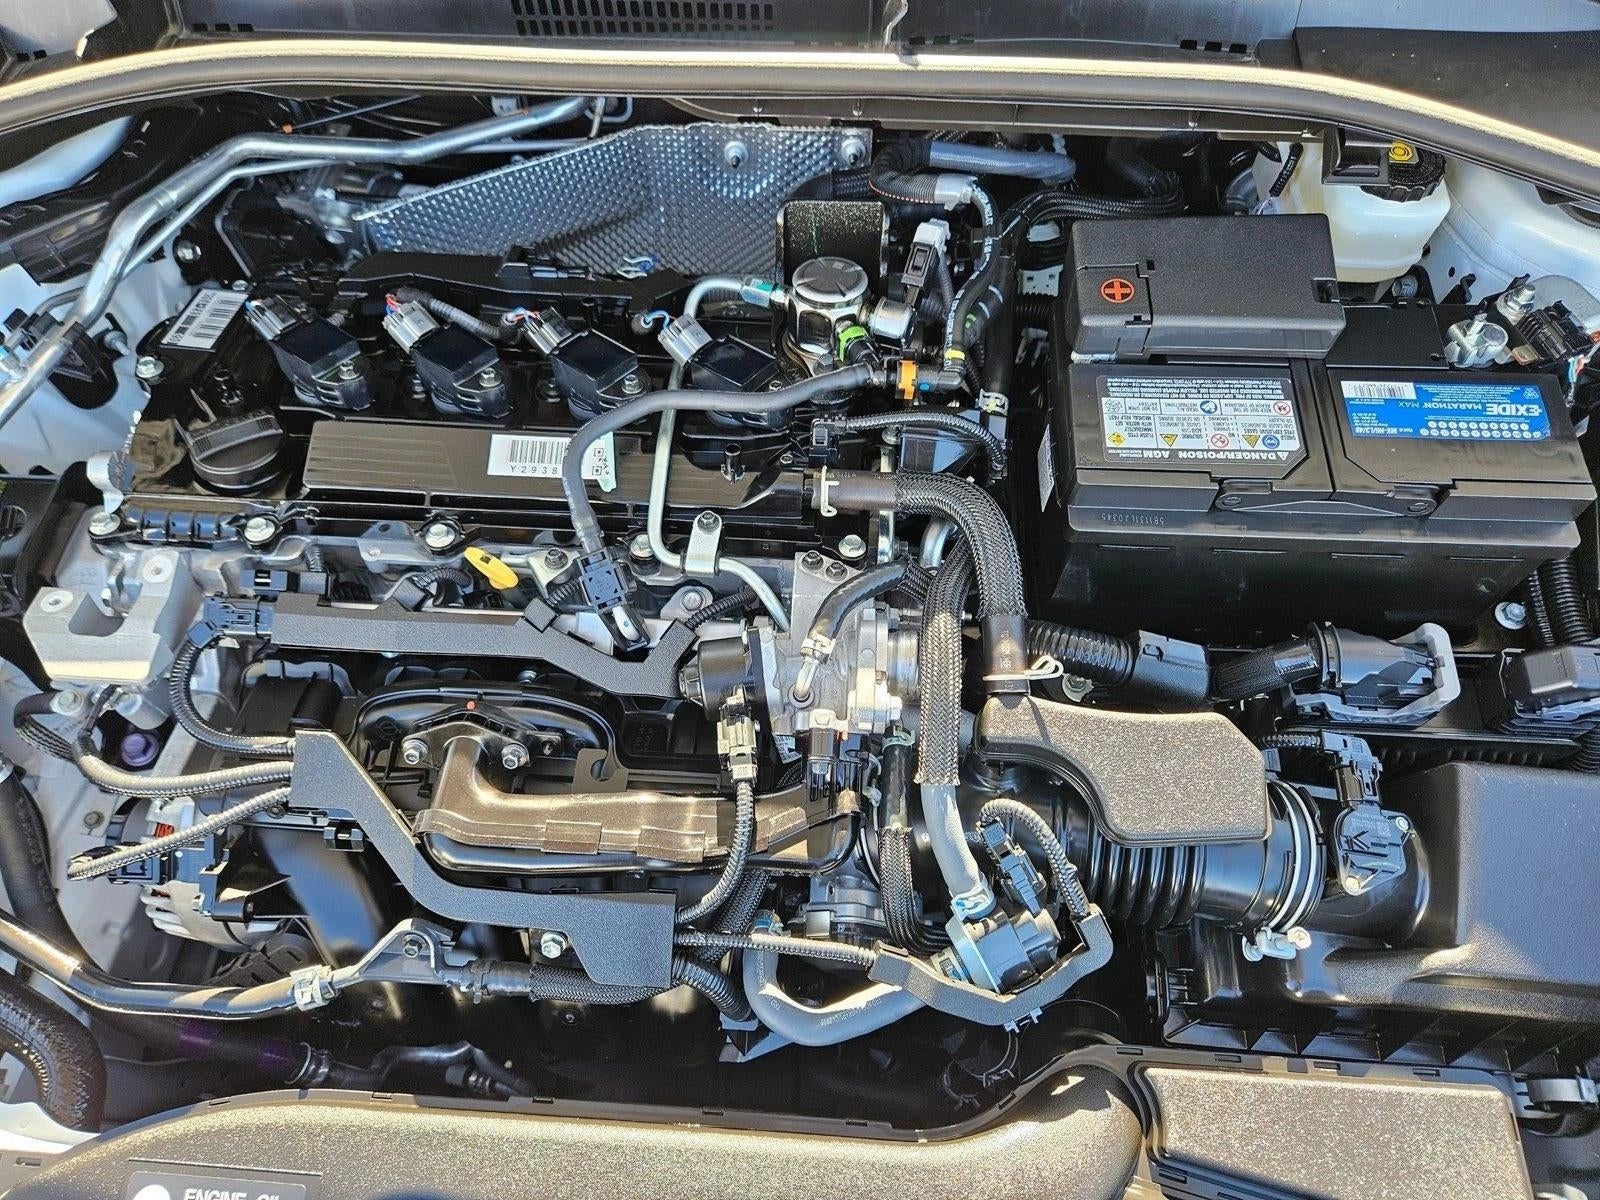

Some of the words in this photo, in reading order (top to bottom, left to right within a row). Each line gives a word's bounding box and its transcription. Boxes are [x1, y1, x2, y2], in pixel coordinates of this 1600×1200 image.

[1424, 402, 1482, 410] MARATHON
[1486, 404, 1542, 416] EXIDE
[1143, 450, 1170, 458] AGM
[1179, 451, 1276, 459] DANGER/POISON
